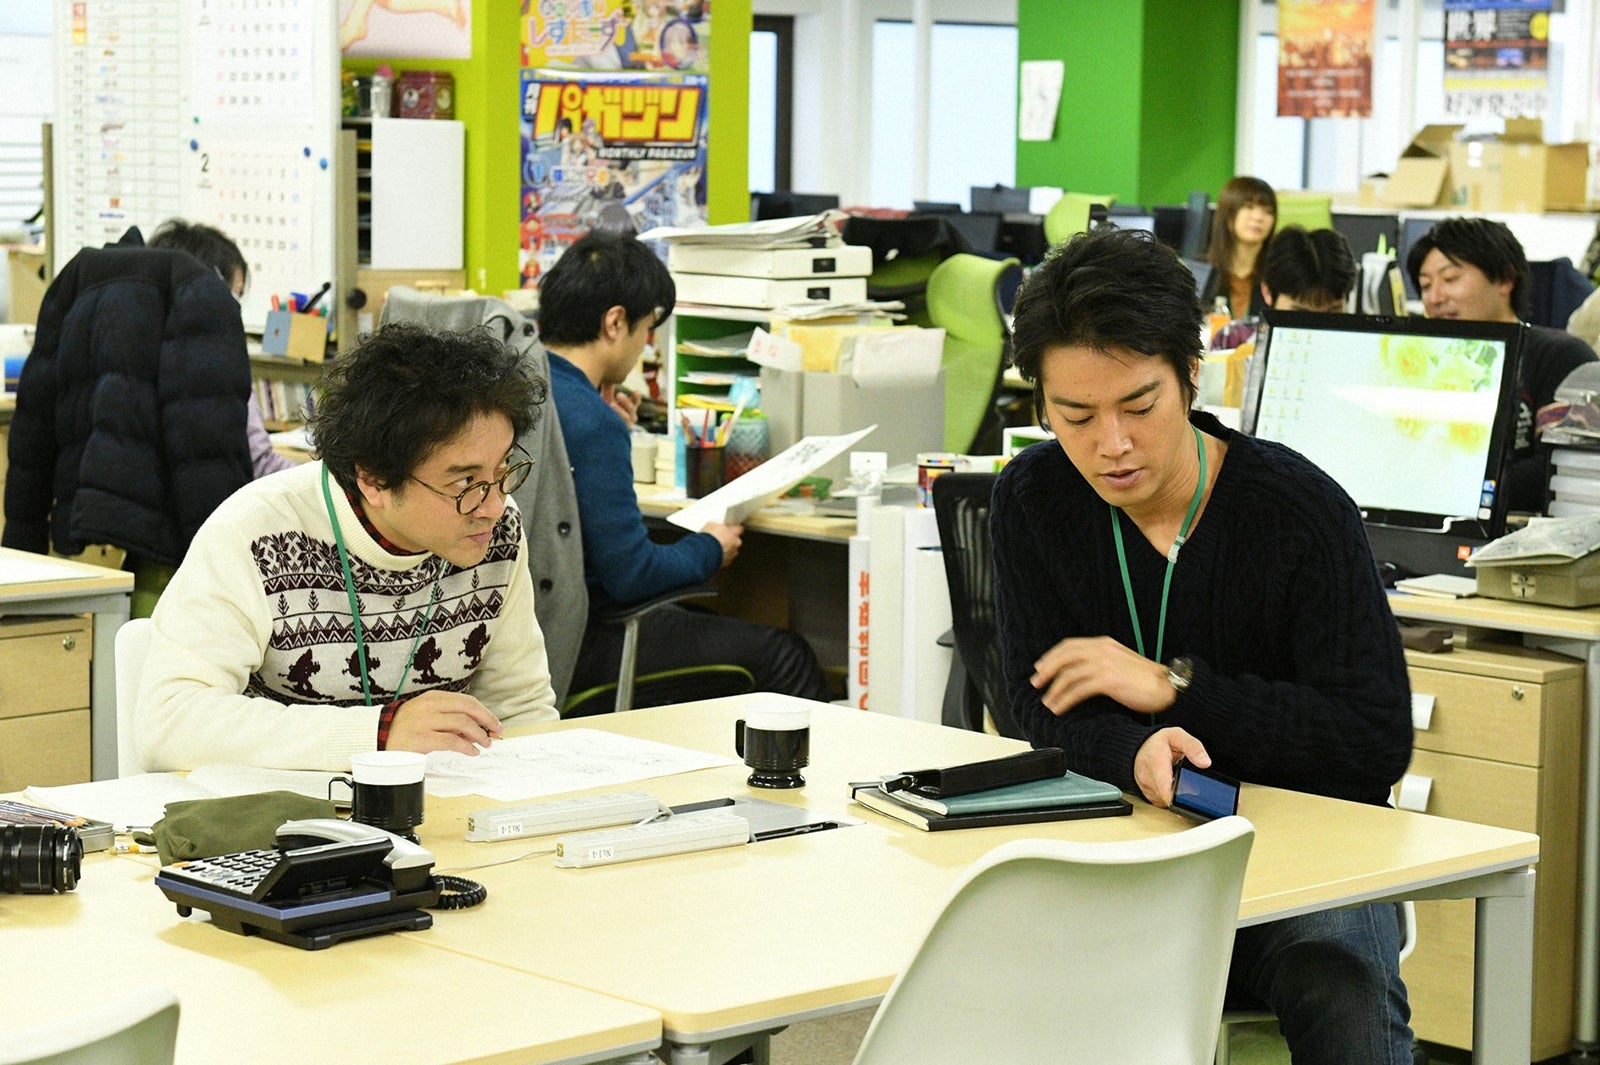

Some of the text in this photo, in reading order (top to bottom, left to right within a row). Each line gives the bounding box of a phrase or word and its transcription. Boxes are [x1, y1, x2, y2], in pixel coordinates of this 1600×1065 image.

[534, 83, 700, 142] パガジン
[598, 147, 646, 158] MONTHLY
[201, 153, 209, 172] 2
